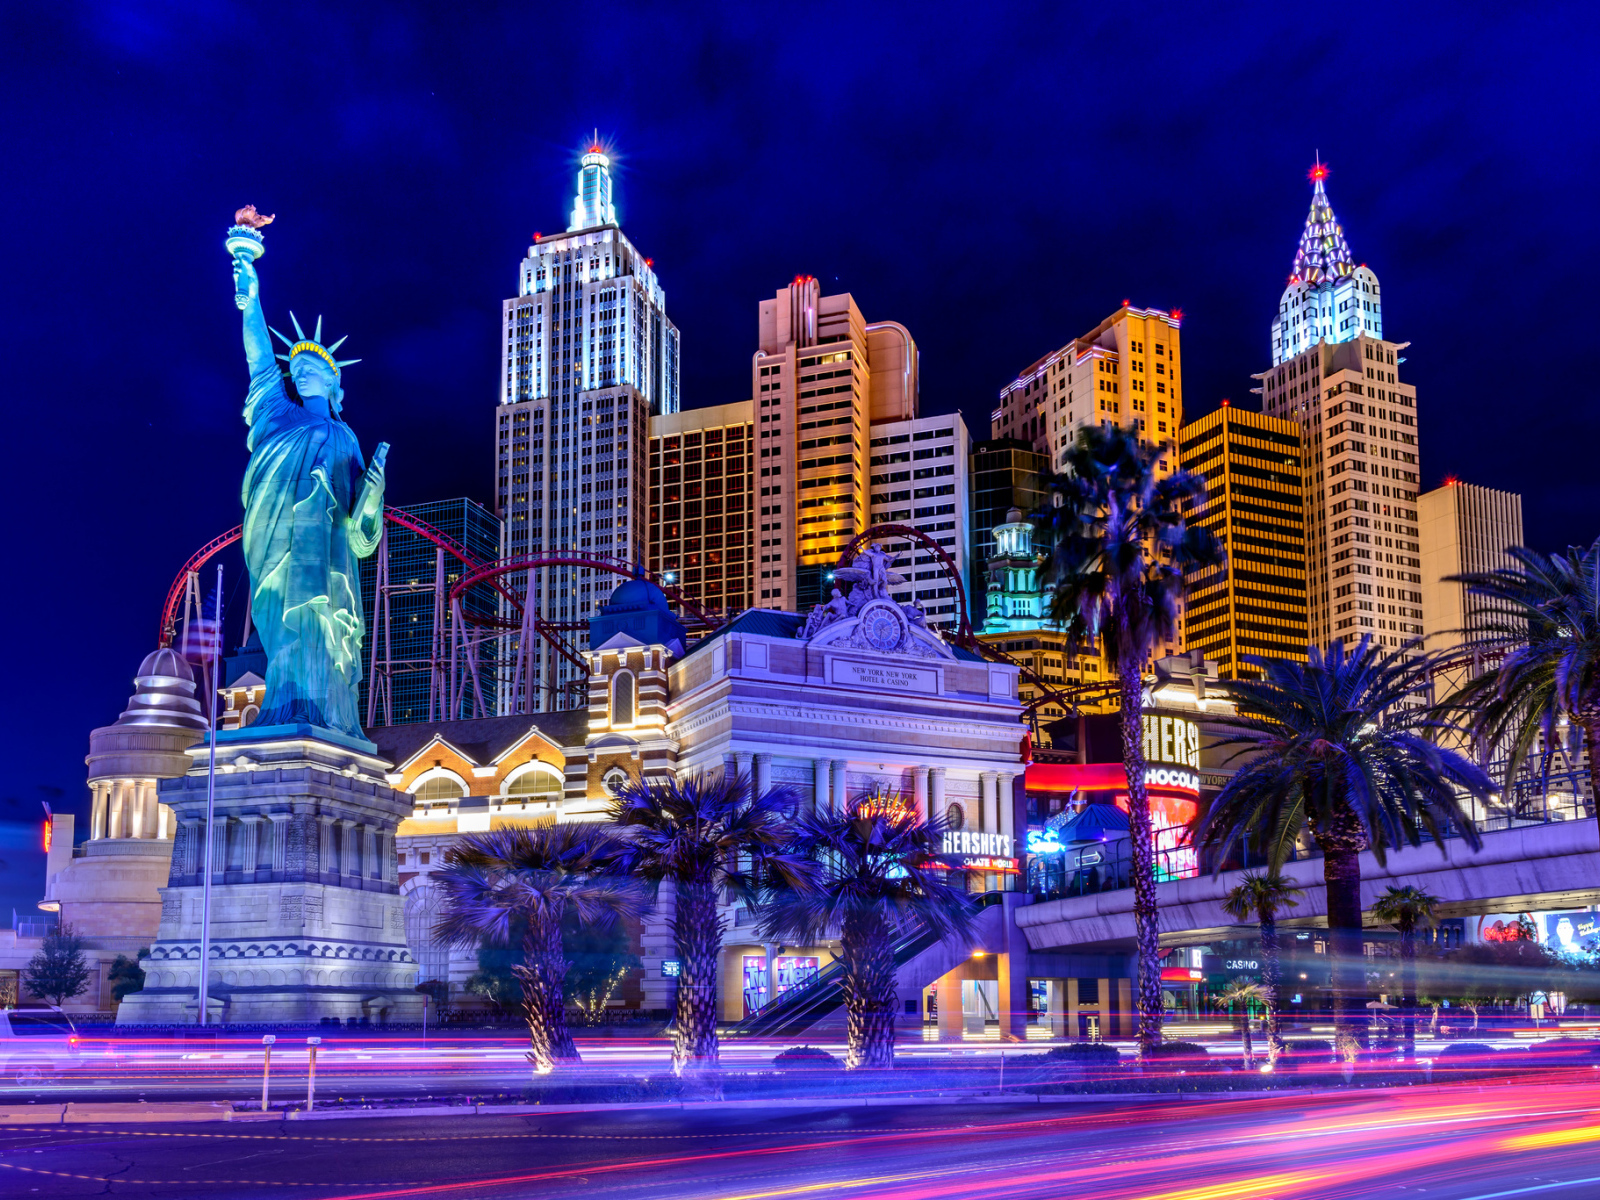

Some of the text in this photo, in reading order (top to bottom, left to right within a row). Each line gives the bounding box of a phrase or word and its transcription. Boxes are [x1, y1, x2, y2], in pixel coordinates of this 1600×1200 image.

[860, 675, 879, 683] HOTEL
[901, 672, 917, 680] YORK
[943, 832, 1010, 856] HERSHEY'S
[1226, 960, 1259, 970] CASINO
